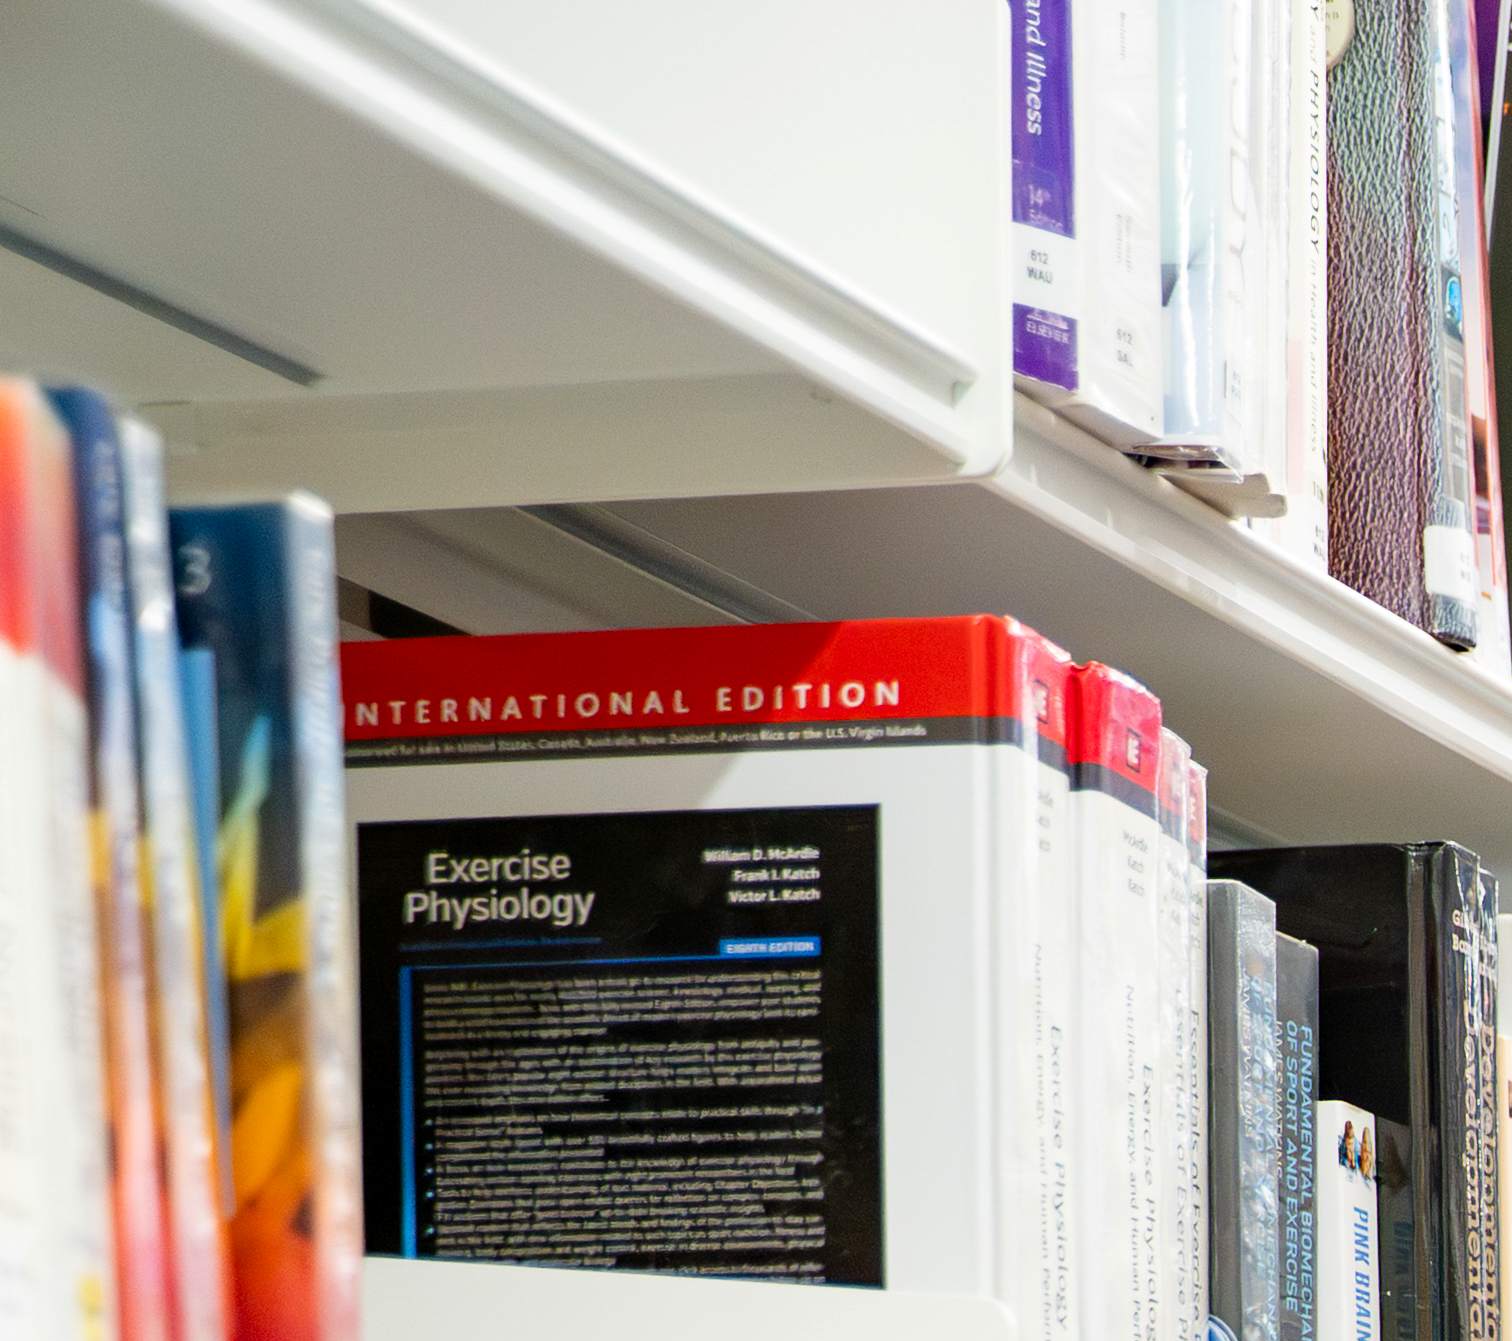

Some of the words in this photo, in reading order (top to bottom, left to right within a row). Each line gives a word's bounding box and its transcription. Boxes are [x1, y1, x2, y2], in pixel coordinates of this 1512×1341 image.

[1027, 51, 1045, 135] Illness
[1309, 68, 1320, 257] PHYSIOLOGY
[355, 690, 689, 727] NTERNATIONAL
[715, 680, 901, 712] EDITION
[760, 729, 784, 741] Rico
[804, 728, 824, 740] the
[826, 727, 847, 739] U.S.
[848, 726, 884, 741] Virgin
[886, 725, 927, 737] Islands
[425, 849, 571, 885] Exercise
[703, 847, 751, 863] William
[752, 847, 767, 861] D.
[768, 846, 820, 861] McArdle
[732, 869, 770, 882] Frank
[782, 867, 820, 881] Katch
[404, 886, 595, 931] Physiology
[728, 889, 767, 903] Victor
[782, 888, 820, 902] Katch
[726, 943, 767, 954] EIGHTH
[768, 941, 814, 953] EDITION
[1285, 1019, 1299, 1052] OF
[1050, 1024, 1065, 1150] Exercise
[1285, 1054, 1299, 1138] SPORT
[1141, 1064, 1155, 1187] Exercise
[1299, 1024, 1314, 1206] FUNDAMENTAL
[1285, 1138, 1299, 1191] AND
[1054, 1161, 1070, 1331] Physiology
[1177, 1186, 1190, 1306] Exercise
[1285, 1193, 1299, 1313] EXERCISE
[1353, 1207, 1371, 1265] PINK
